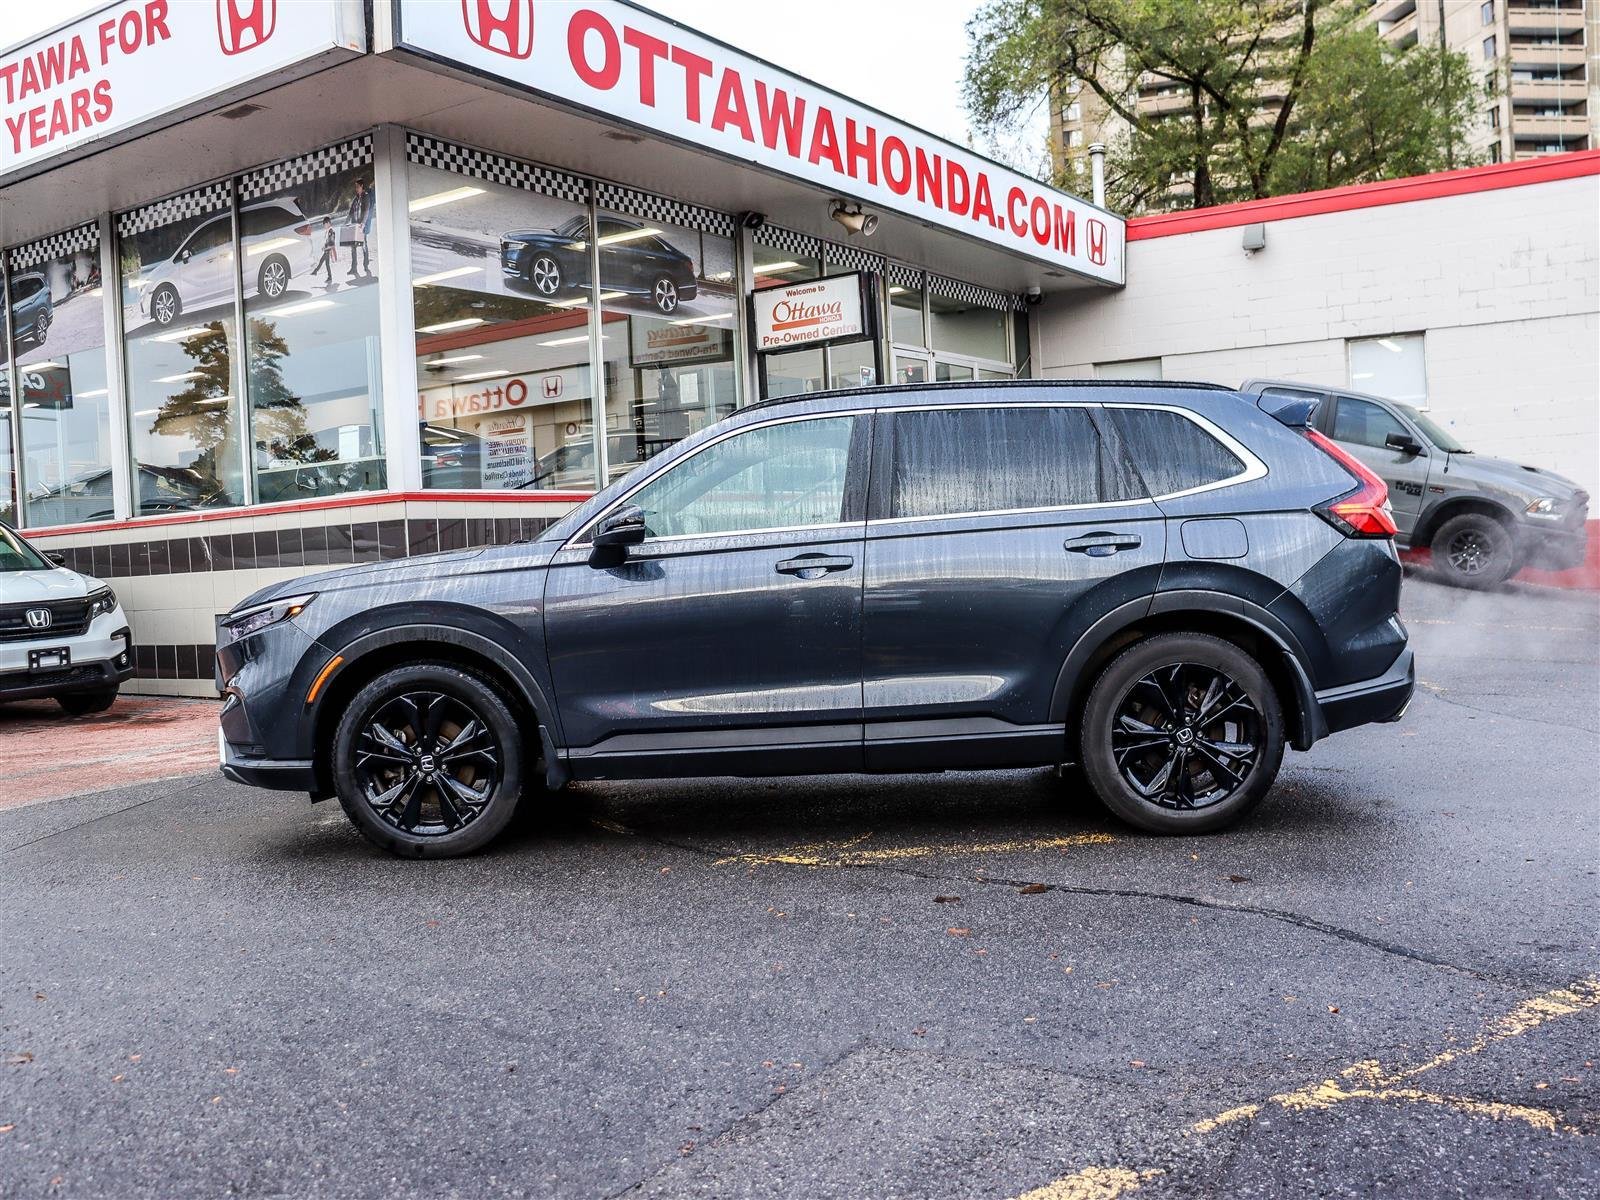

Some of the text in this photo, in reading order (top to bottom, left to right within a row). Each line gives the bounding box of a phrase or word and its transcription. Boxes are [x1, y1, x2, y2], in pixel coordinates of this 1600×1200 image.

[0, 0, 172, 104] TAWA FOR
[5, 79, 113, 154] YEARS
[567, 9, 1076, 256] OTTAWAHONDA.COM
[786, 284, 826, 298] Welcome to
[772, 299, 842, 323] Ottawa
[819, 314, 840, 323] HONDA
[762, 323, 858, 346] Pre-Owned Centre
